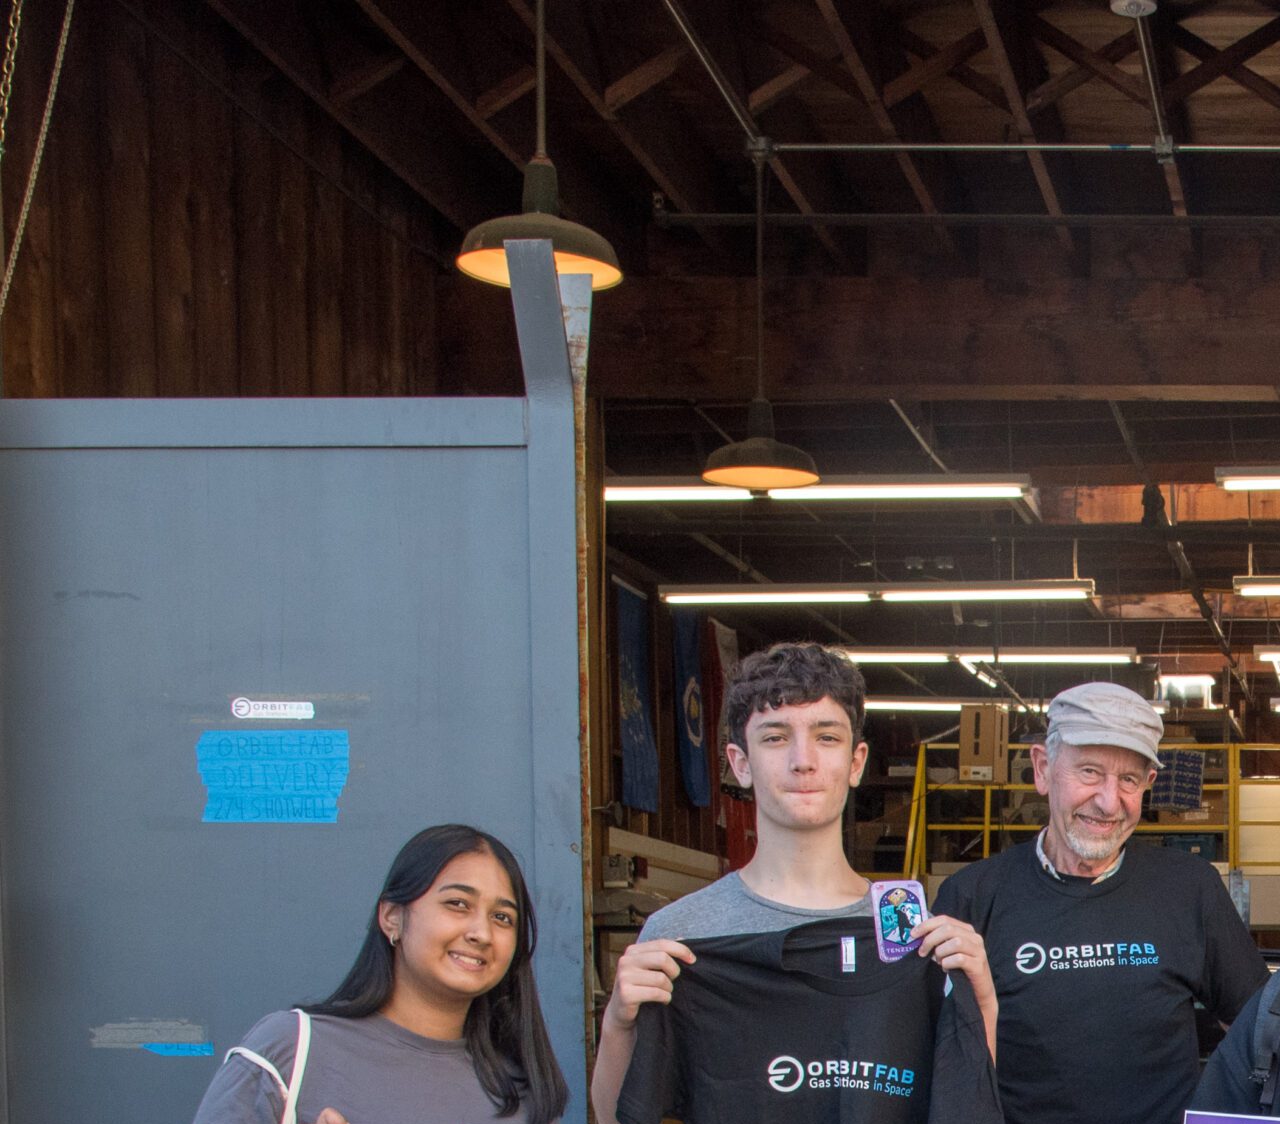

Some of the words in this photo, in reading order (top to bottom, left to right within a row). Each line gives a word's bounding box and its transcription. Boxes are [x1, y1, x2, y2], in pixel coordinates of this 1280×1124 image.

[222, 762, 338, 792] DELIVERY
[1050, 960, 1070, 970] Gas
[1073, 957, 1115, 969] Stations
[1118, 955, 1128, 966] in
[809, 1077, 831, 1089] Gas
[873, 1079, 882, 1091] in
